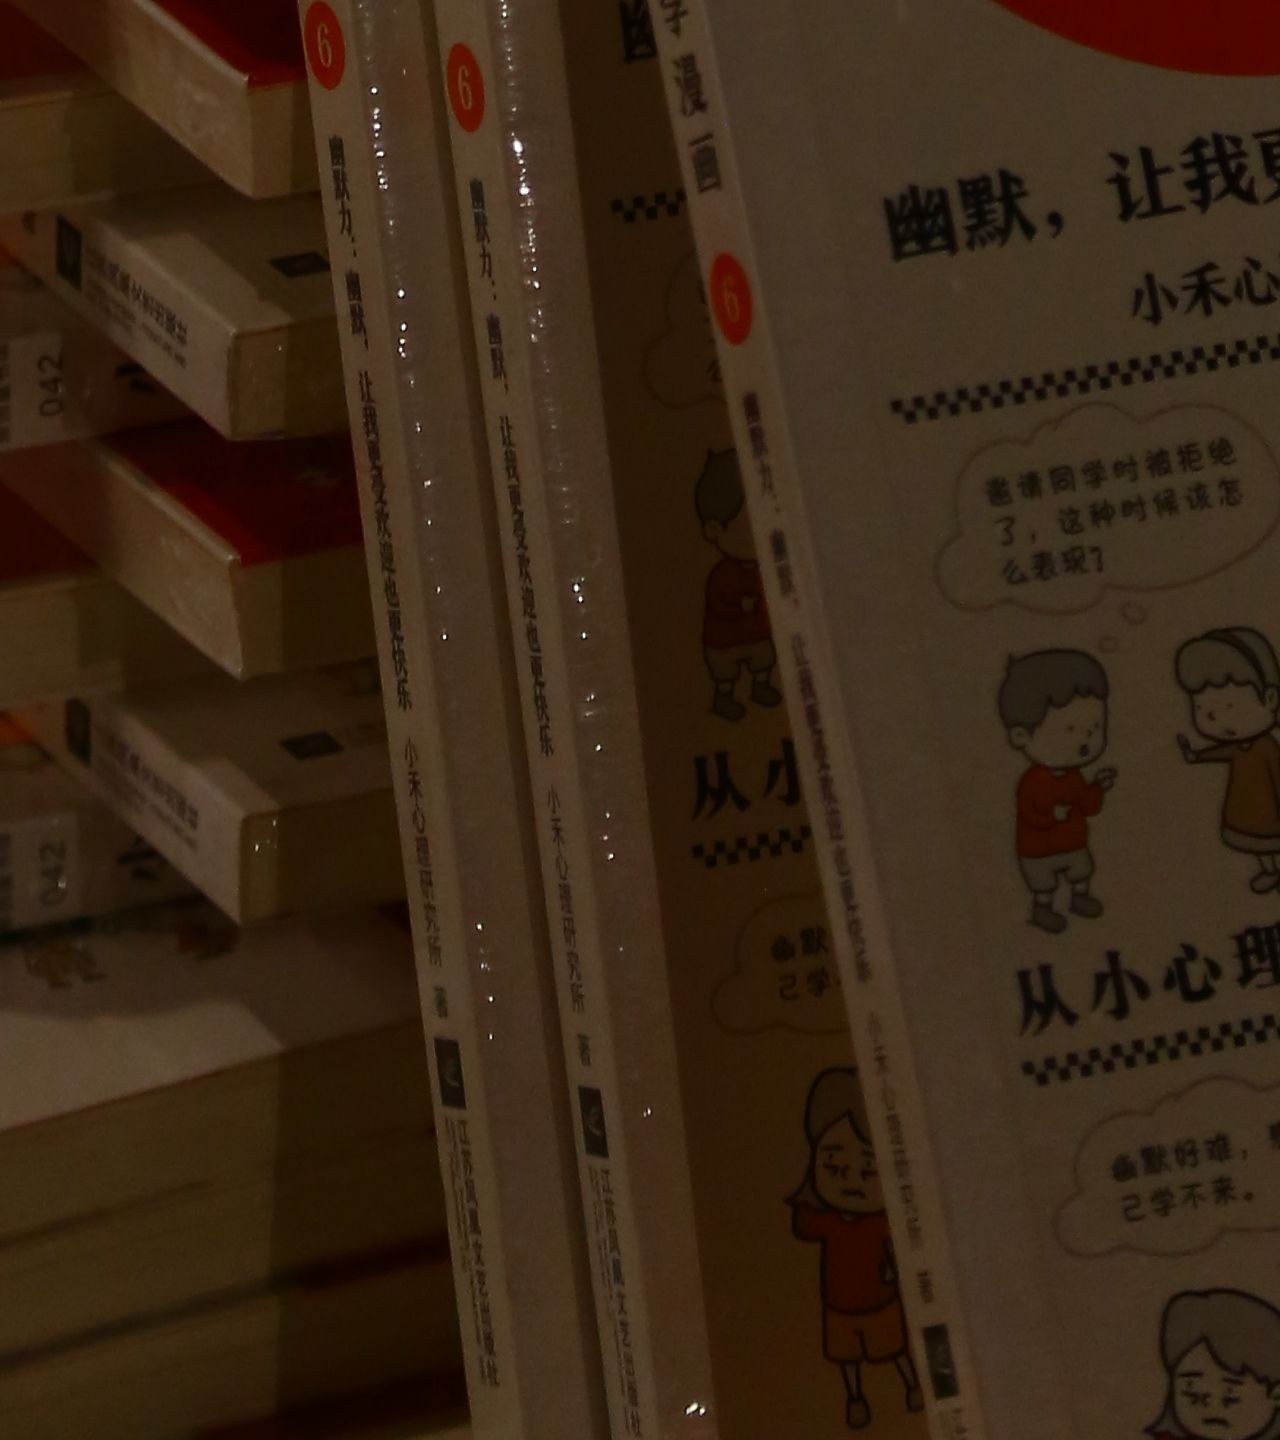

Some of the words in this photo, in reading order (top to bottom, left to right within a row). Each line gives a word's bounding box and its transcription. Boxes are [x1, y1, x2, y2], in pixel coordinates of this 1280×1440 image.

[37, 354, 63, 418] 042
[777, 969, 834, 1002] 己学
[1120, 1177, 1255, 1224] 己学不来。
